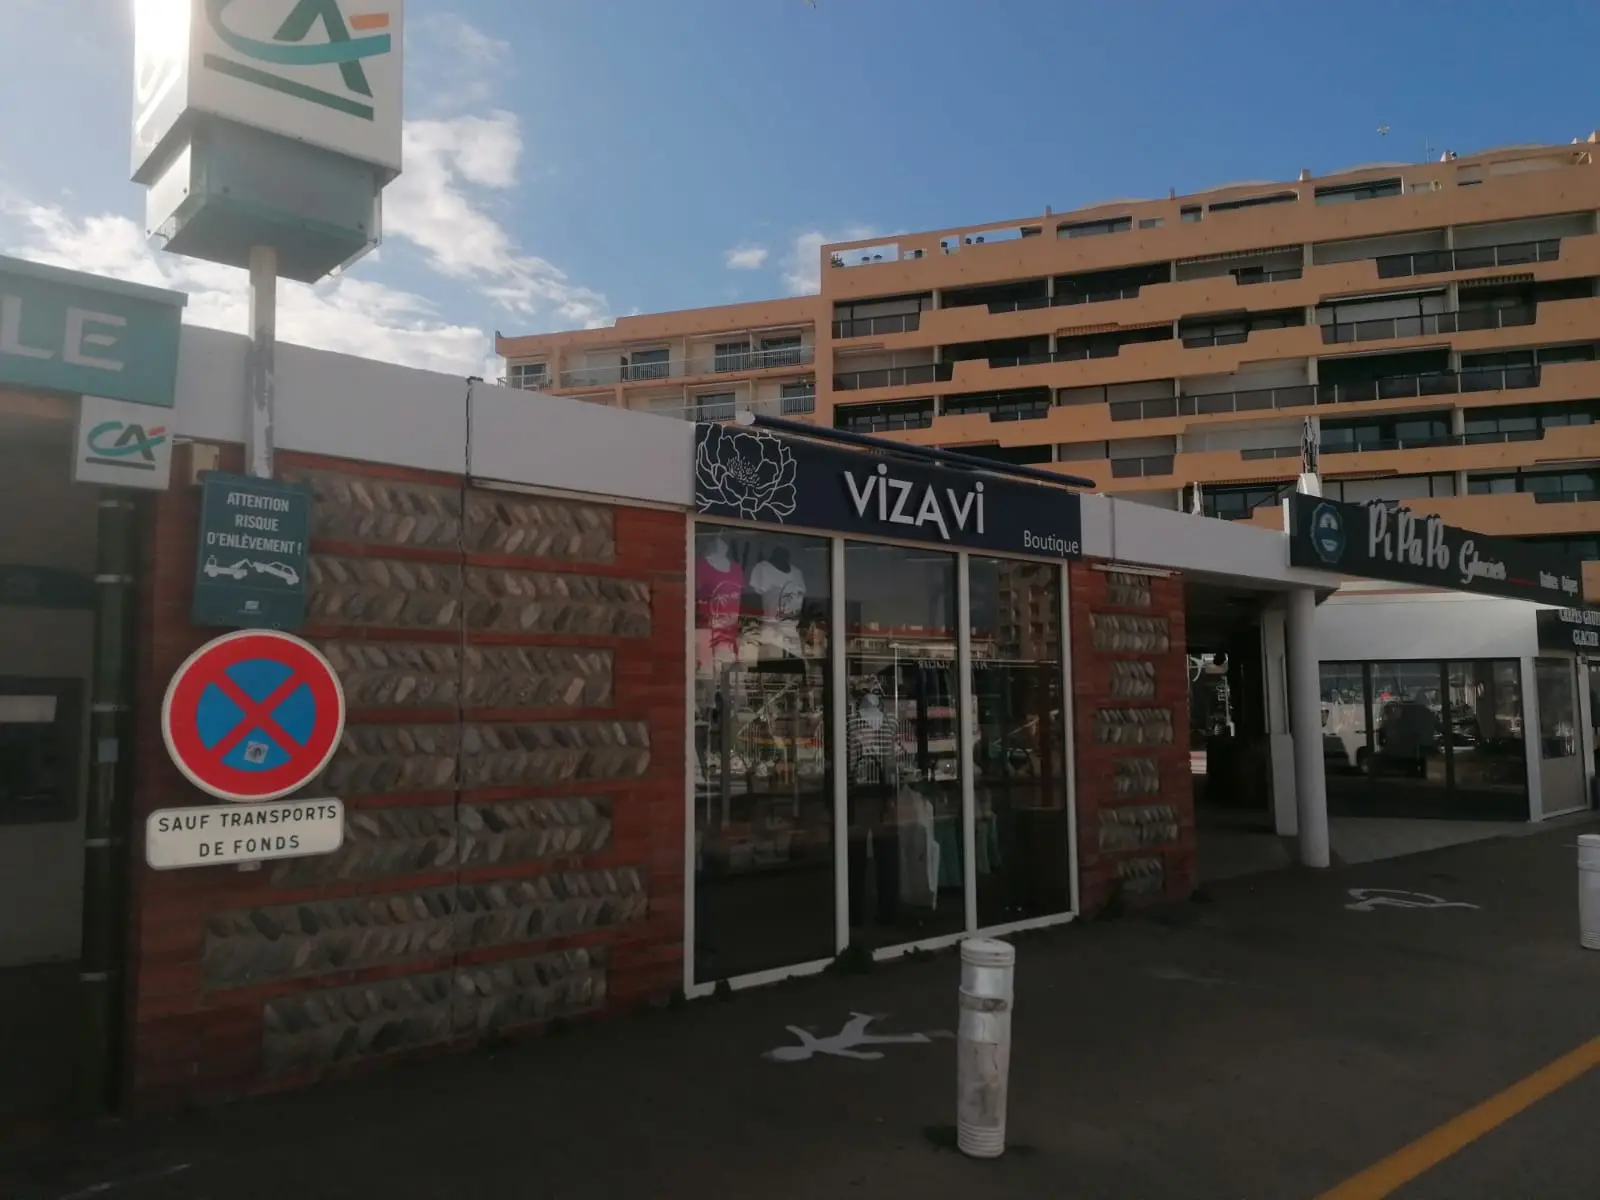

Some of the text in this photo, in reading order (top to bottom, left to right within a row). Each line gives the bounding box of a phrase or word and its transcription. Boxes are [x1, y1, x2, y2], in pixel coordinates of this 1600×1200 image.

[226, 491, 290, 513] ATTENTION
[234, 513, 280, 532] RISQUE
[1023, 529, 1079, 558] Boutique
[158, 805, 337, 833] SAUF TRANSPORTS
[198, 834, 301, 858] DE FONDS
